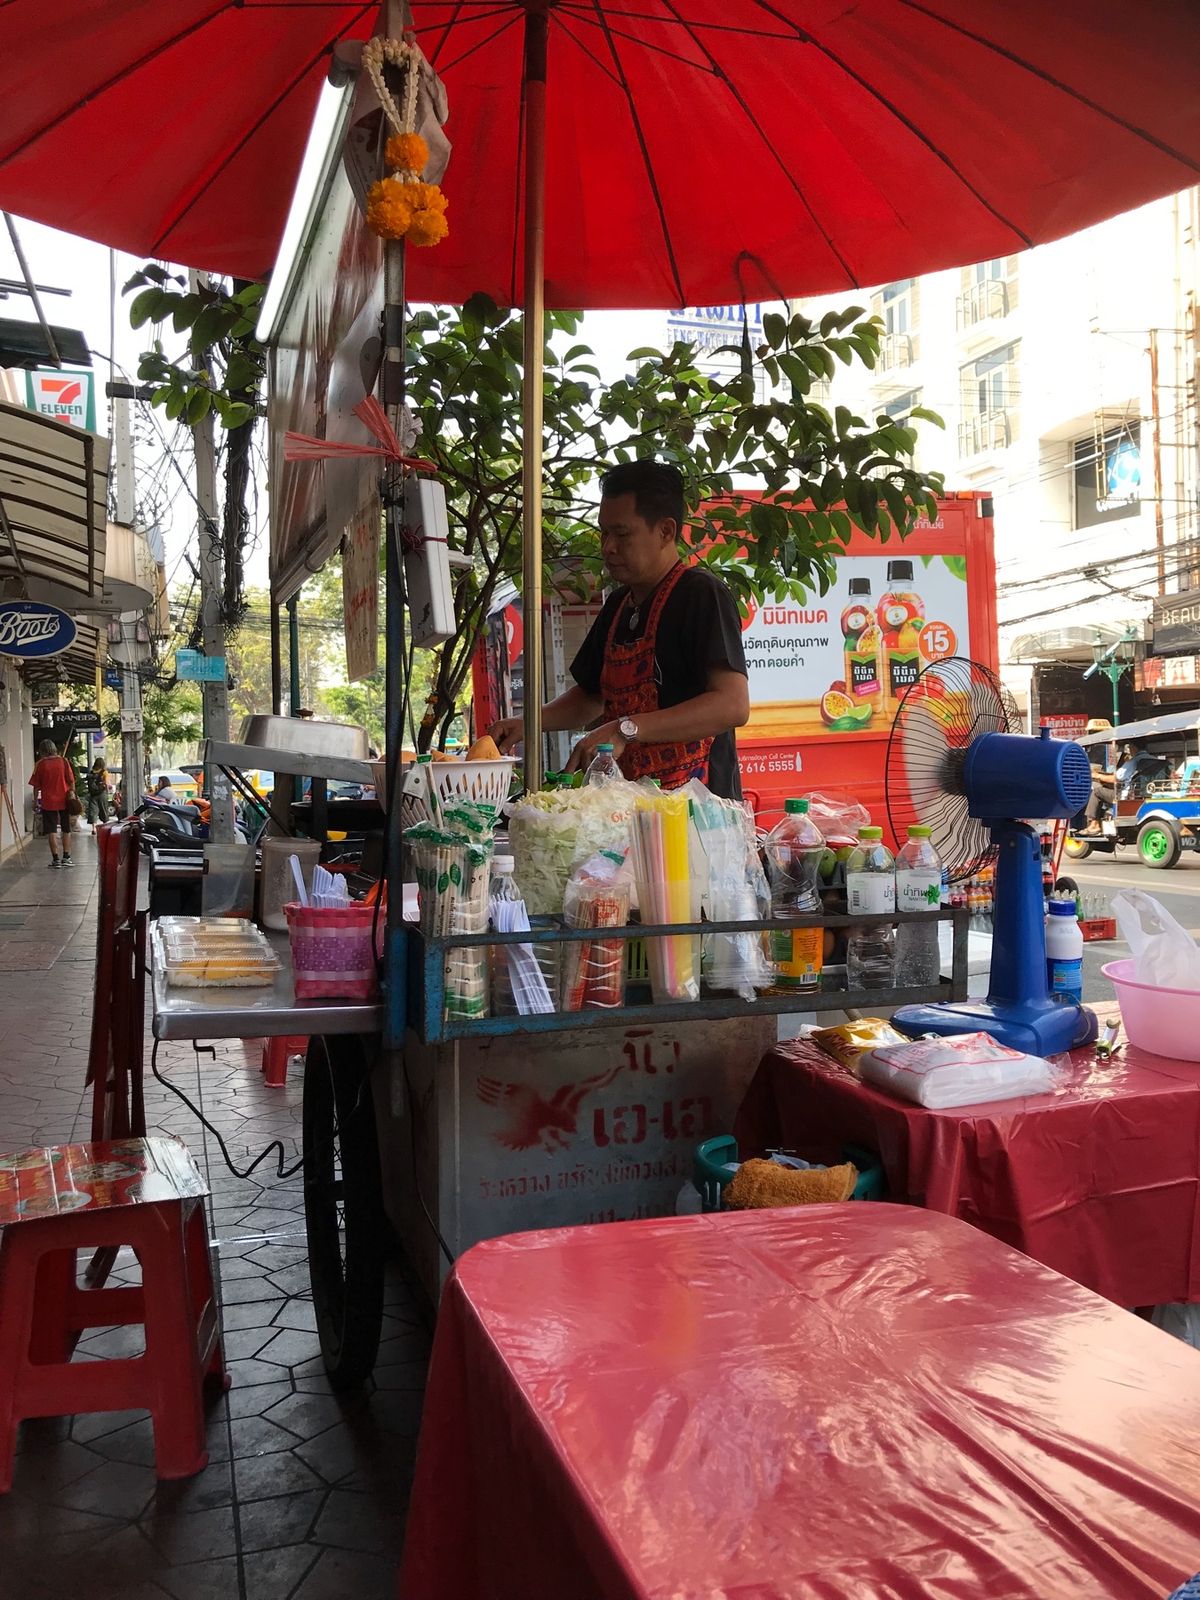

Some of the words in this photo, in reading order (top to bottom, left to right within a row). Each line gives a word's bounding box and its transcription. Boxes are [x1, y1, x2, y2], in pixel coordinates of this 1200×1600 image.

[763, 606, 828, 625] มินิทเมด
[0, 611, 60, 646] Boots
[923, 630, 949, 652] 15
[745, 658, 766, 669] จาก
[746, 762, 766, 773] 616
[768, 760, 794, 772] 5555
